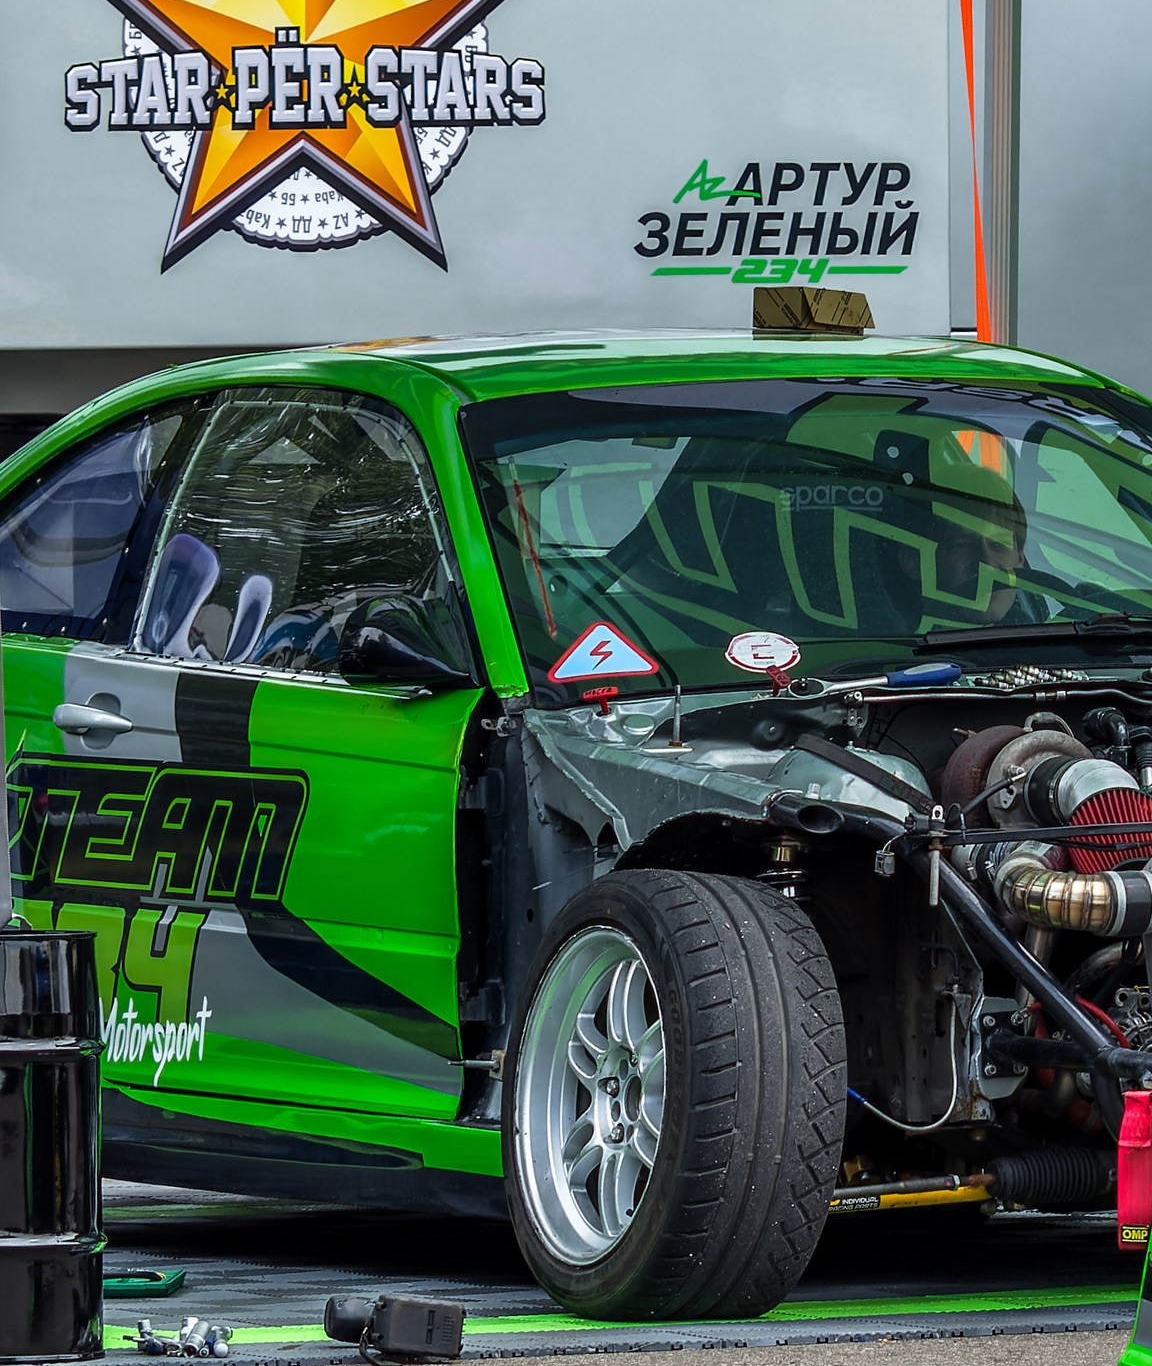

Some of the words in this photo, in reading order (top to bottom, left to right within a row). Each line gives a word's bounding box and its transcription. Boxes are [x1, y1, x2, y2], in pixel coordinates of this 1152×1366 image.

[65, 50, 212, 129] STAR
[366, 47, 546, 128] STARS
[725, 162, 912, 207] АРТУР
[243, 209, 271, 229] Kab
[633, 199, 920, 259] ЗЕЛЕНЫЙ
[731, 258, 830, 284] 234
[781, 484, 883, 512] sparco
[6, 757, 308, 901] TEAM
[98, 996, 212, 1087] Motorsport
[1122, 1229, 1148, 1240] OMP
